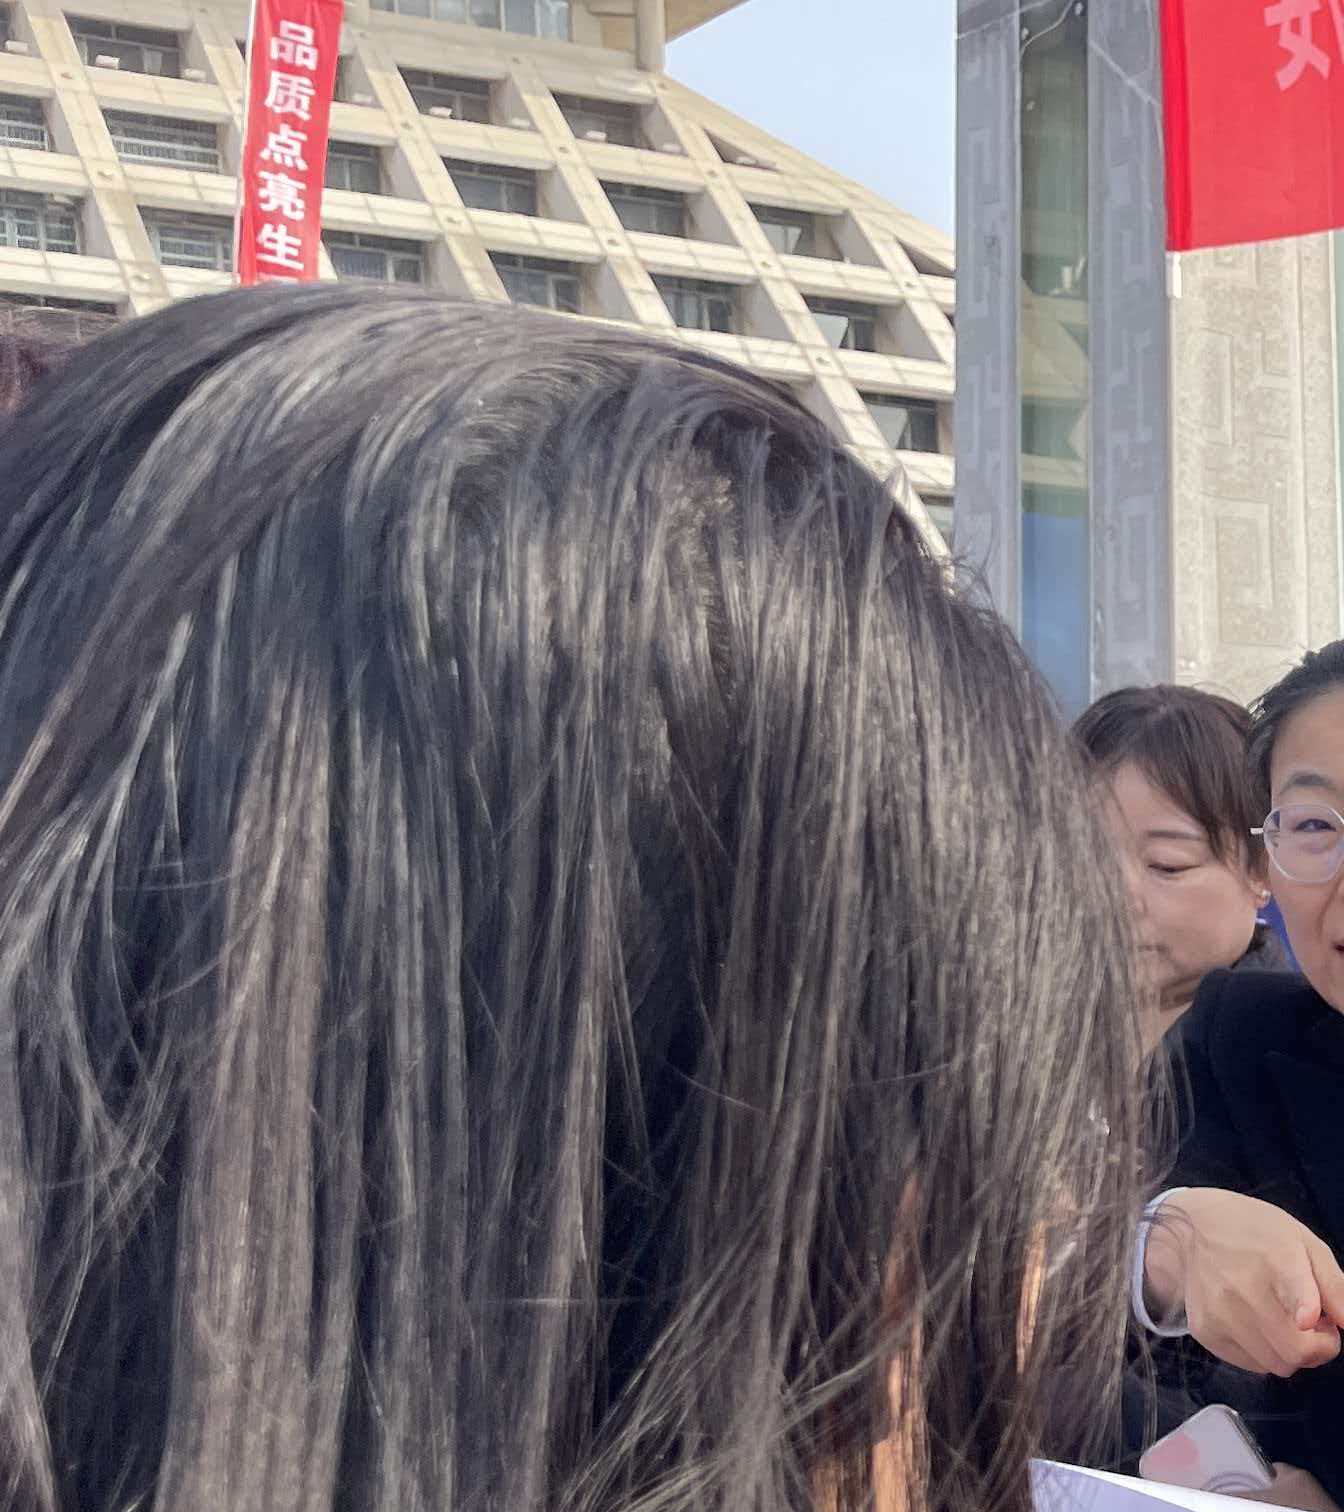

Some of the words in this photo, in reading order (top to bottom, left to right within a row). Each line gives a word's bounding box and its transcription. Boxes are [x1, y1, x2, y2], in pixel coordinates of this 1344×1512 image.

[255, 20, 319, 281] 品质点亮生
